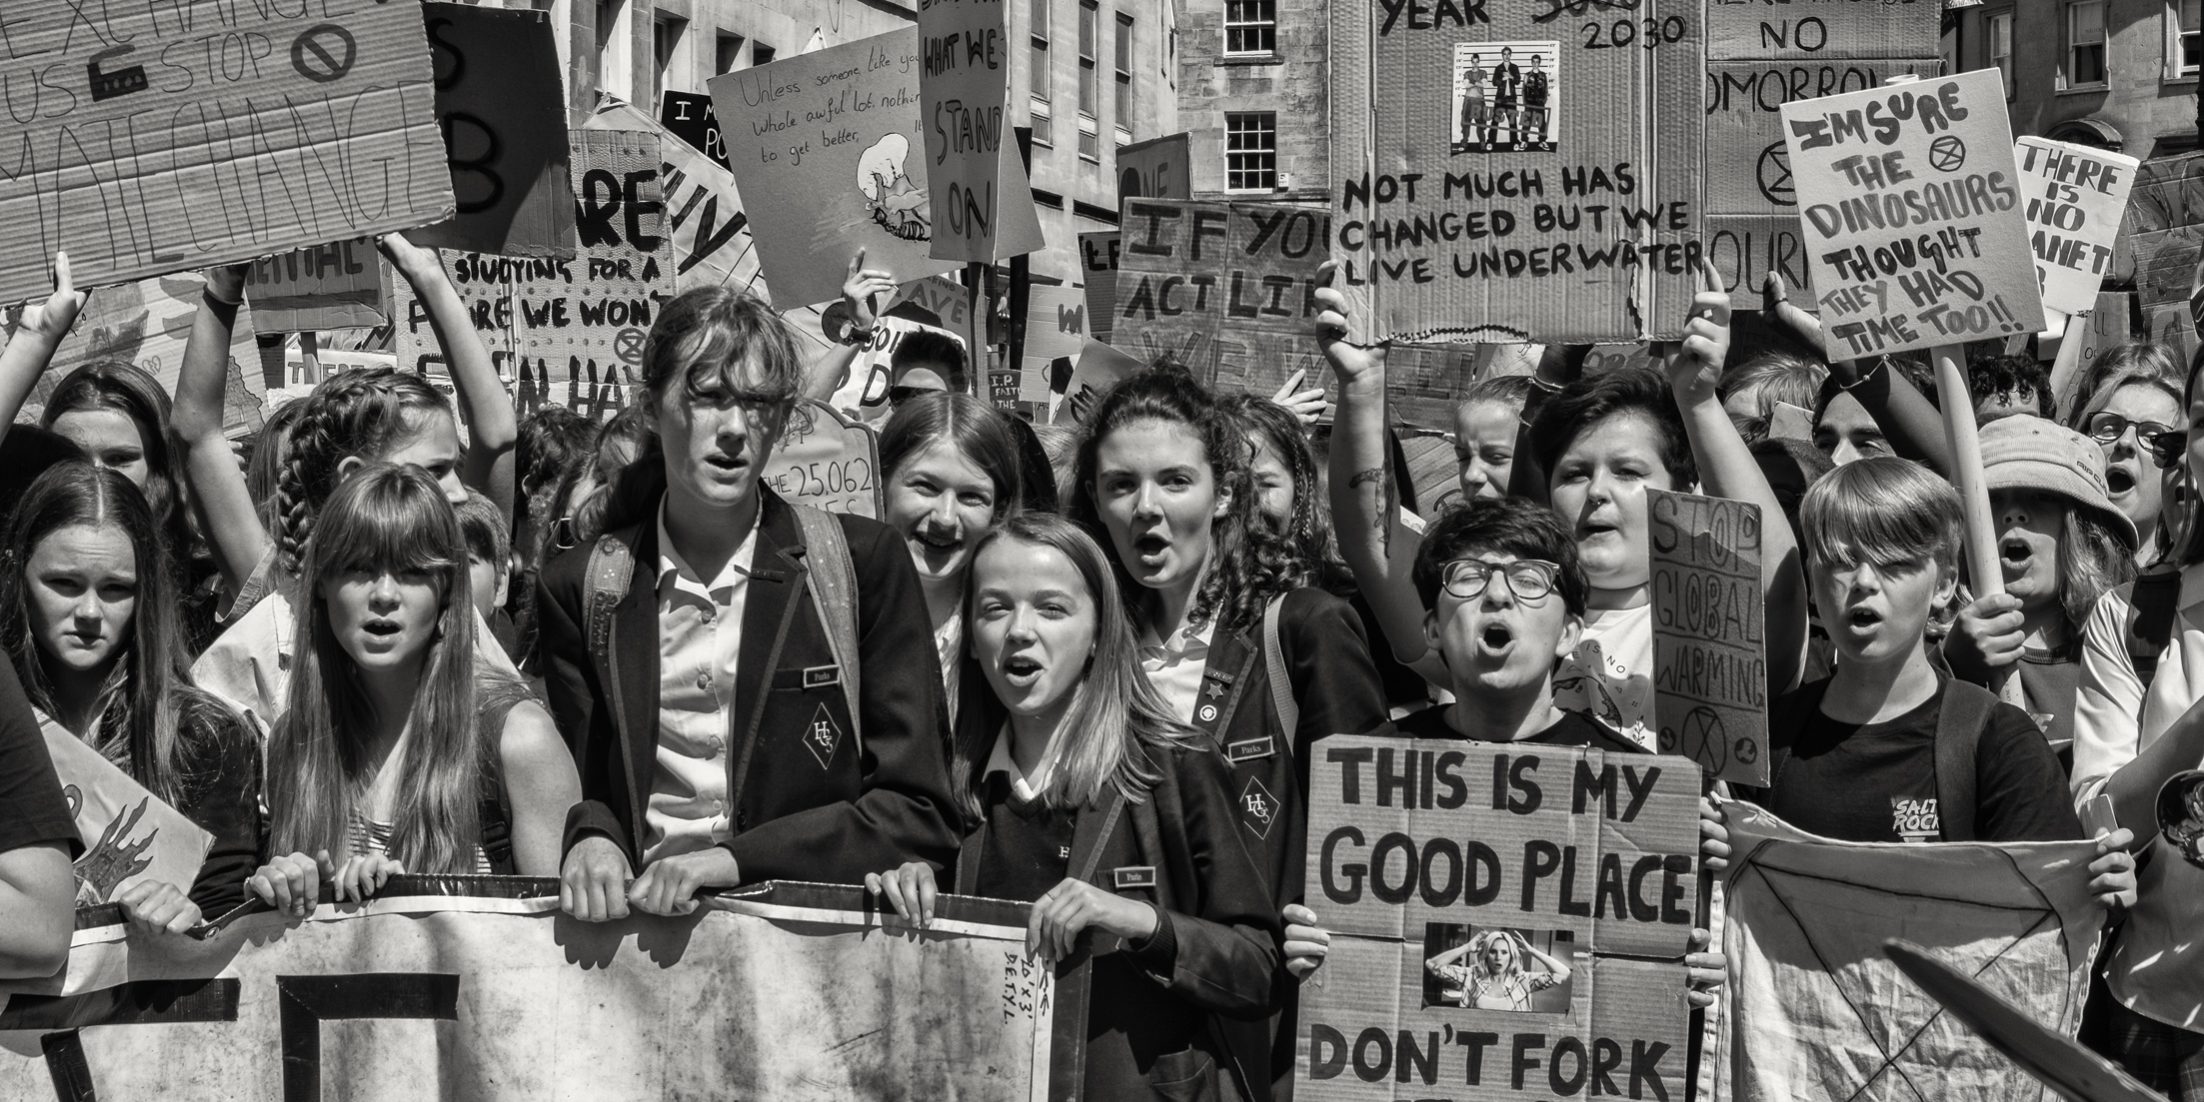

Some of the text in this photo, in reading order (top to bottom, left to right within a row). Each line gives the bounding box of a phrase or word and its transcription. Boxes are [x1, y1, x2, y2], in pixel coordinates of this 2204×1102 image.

[1380, 0, 1490, 37] YEAR
[1581, 15, 1687, 50] 2030
[1759, 16, 1828, 51] NO
[924, 28, 998, 79] WHAT WE
[4, 32, 273, 124] US STOP
[738, 69, 801, 107] Unless
[815, 67, 861, 87] someone
[675, 101, 692, 121] I
[806, 89, 845, 123] awful
[1866, 82, 1969, 146] SURE
[761, 146, 778, 164] to
[789, 142, 810, 167] get
[935, 100, 1001, 166] STAND
[1342, 162, 1636, 213] NOT MUCH HAS
[1831, 150, 1915, 191] THE
[2017, 142, 2123, 197] THERE
[2045, 181, 2080, 204] IS
[948, 180, 991, 240] ON
[1338, 201, 1689, 252] CHANGED BUT WE
[1804, 171, 2017, 239] DINOSAURS
[2026, 197, 2086, 232] NO
[1129, 202, 1228, 262] IF
[1821, 225, 1982, 282] THOUGHT
[455, 252, 661, 286] STUDYING FOR A
[1344, 239, 1704, 286] LIVE UNDERWATER
[521, 297, 572, 330] WE
[1123, 274, 1217, 322] ACT
[1819, 269, 1985, 317] THEY HAD
[1831, 313, 1920, 355] TIME
[789, 457, 872, 497] 25.062
[1653, 494, 1763, 573] STOP
[1654, 568, 1762, 644] GLOBAL
[1655, 637, 1765, 708] WARMING
[1326, 747, 1662, 823] THIS IS MY
[1893, 798, 1937, 817] SALT
[1319, 825, 1693, 925] GOOD PLACE
[1310, 1022, 1672, 1102] DON'T FORK
